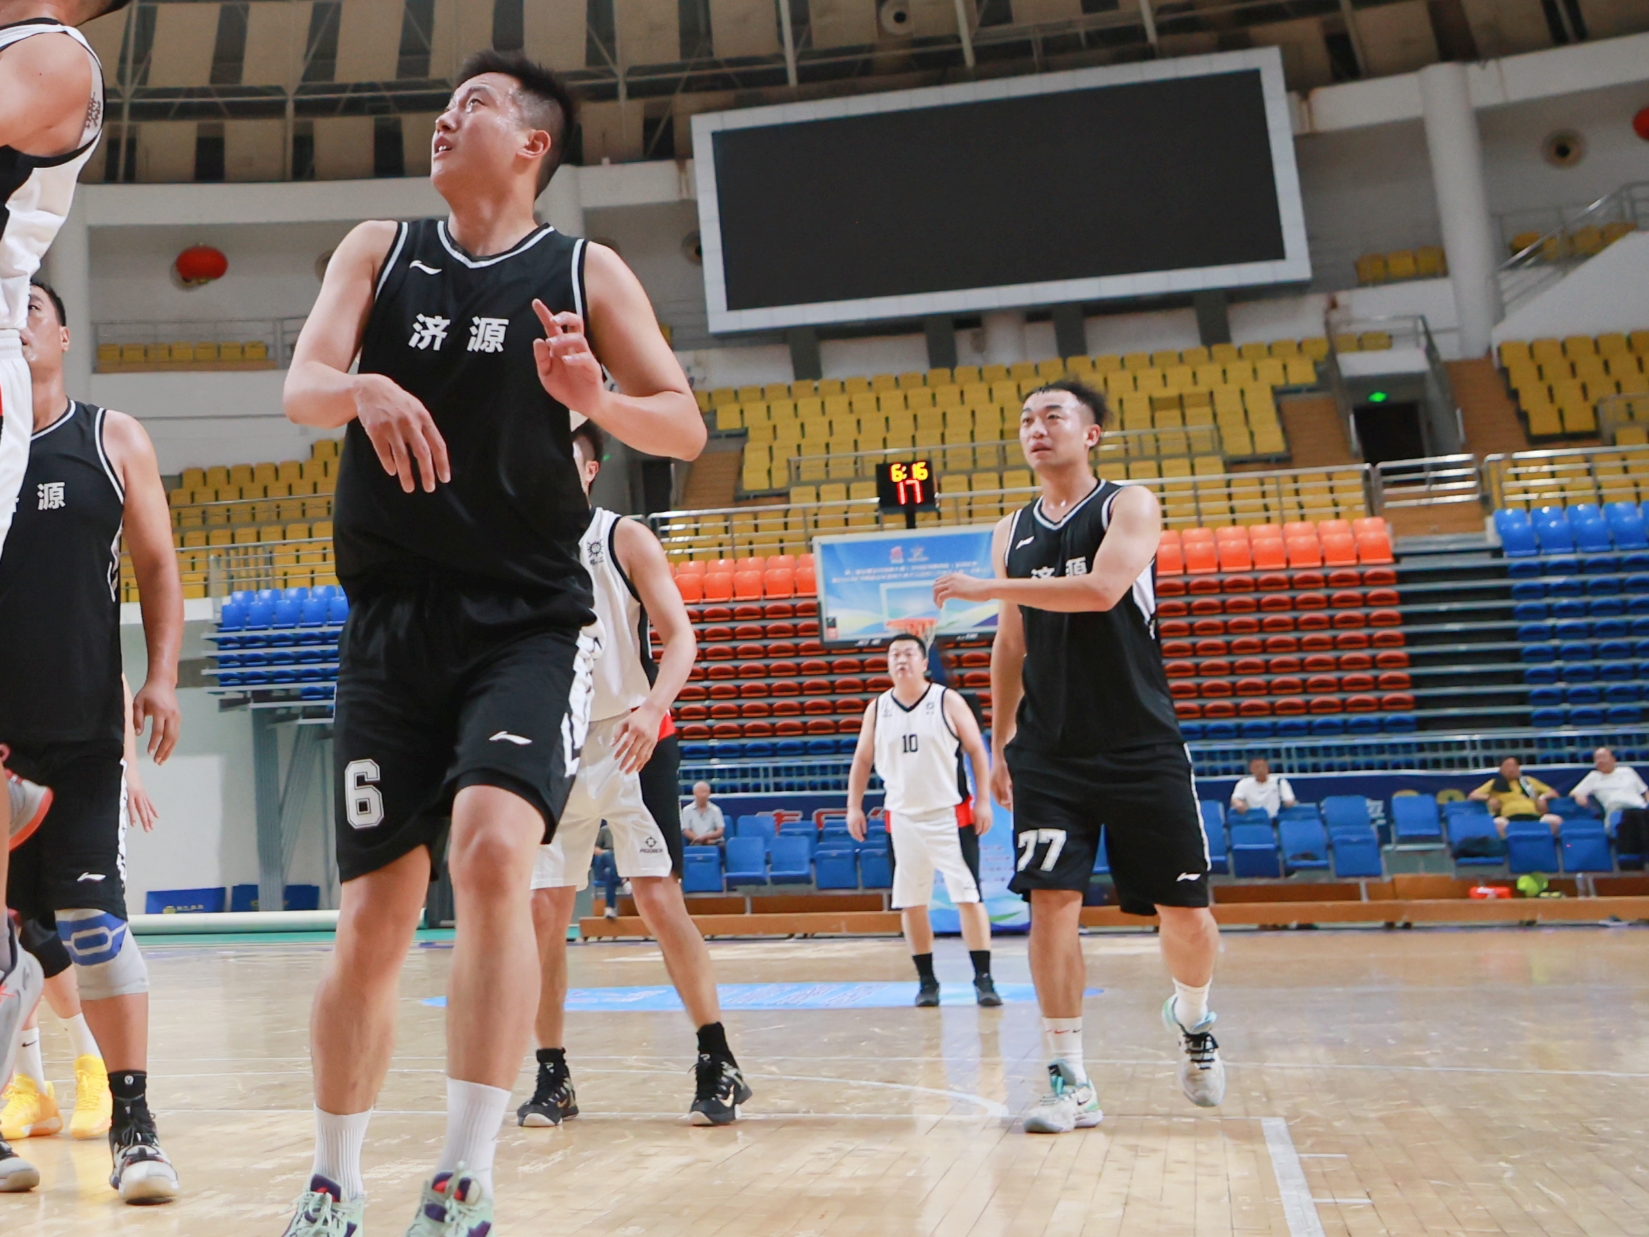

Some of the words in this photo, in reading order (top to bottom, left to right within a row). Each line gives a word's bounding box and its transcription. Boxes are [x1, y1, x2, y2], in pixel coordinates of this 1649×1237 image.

[408, 313, 510, 353] 济源
[898, 479, 922, 505] 17
[902, 733, 919, 754] 10
[344, 758, 385, 830] 6
[1017, 827, 1068, 873] 77
